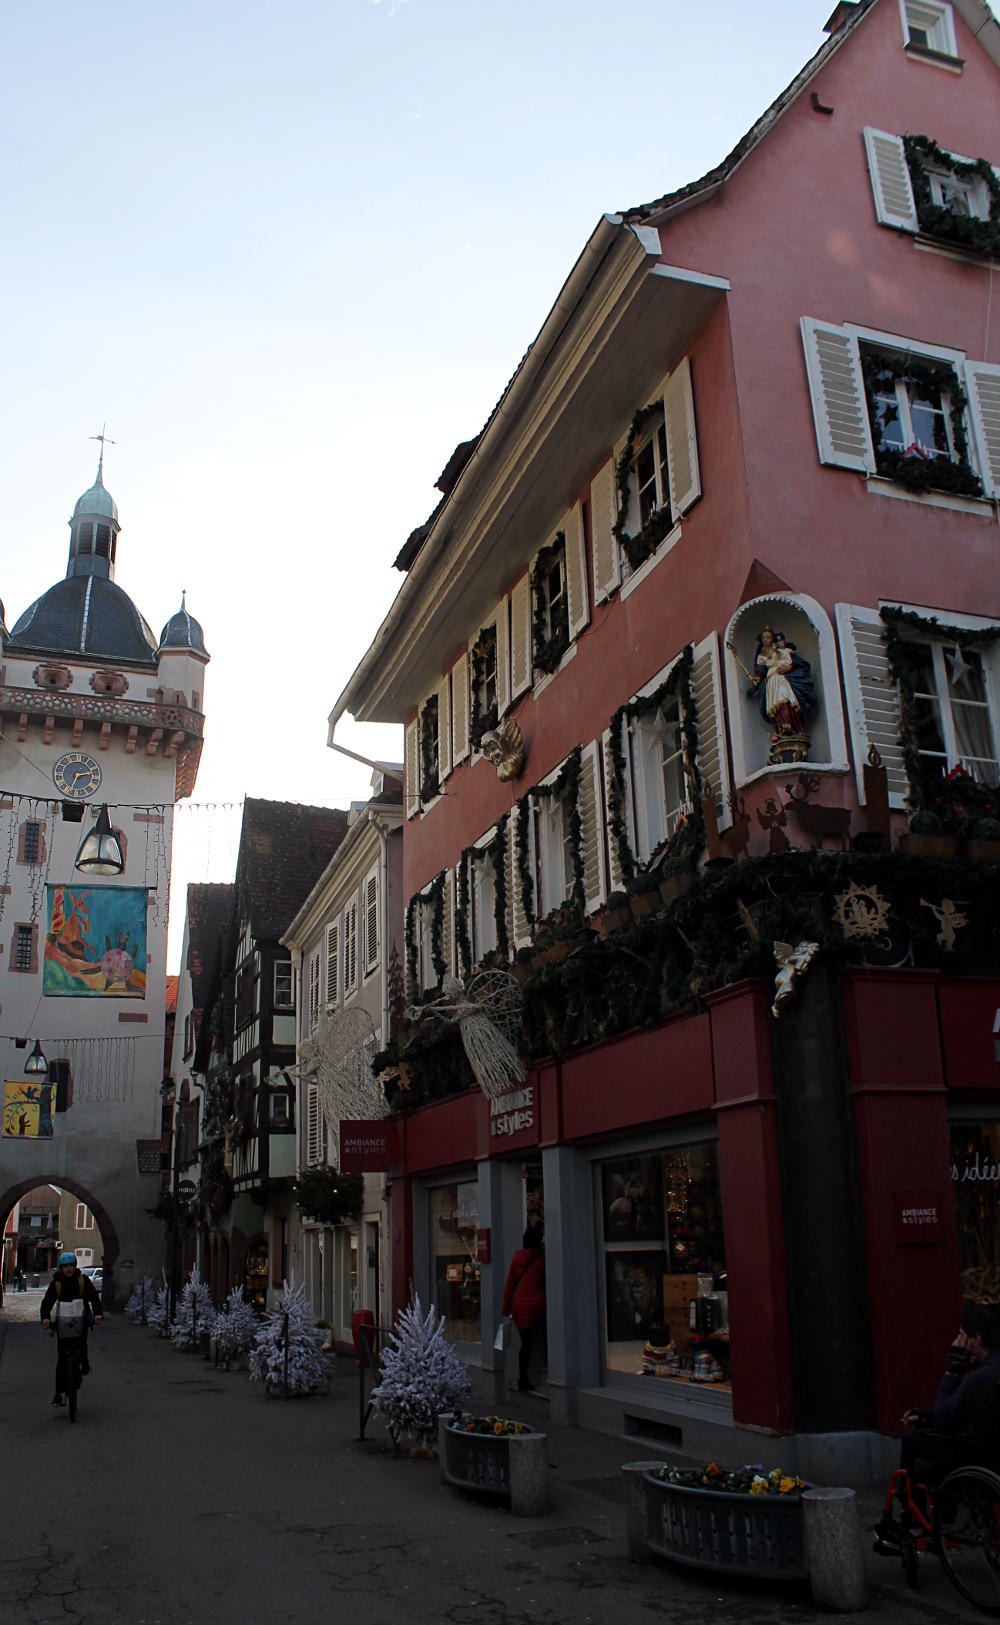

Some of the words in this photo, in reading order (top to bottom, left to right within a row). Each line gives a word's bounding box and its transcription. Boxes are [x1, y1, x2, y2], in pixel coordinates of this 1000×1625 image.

[490, 1086, 534, 1117] AMBCE
[344, 1138, 385, 1146] AMBIANCE
[901, 1208, 936, 1216] AMBIANCE
